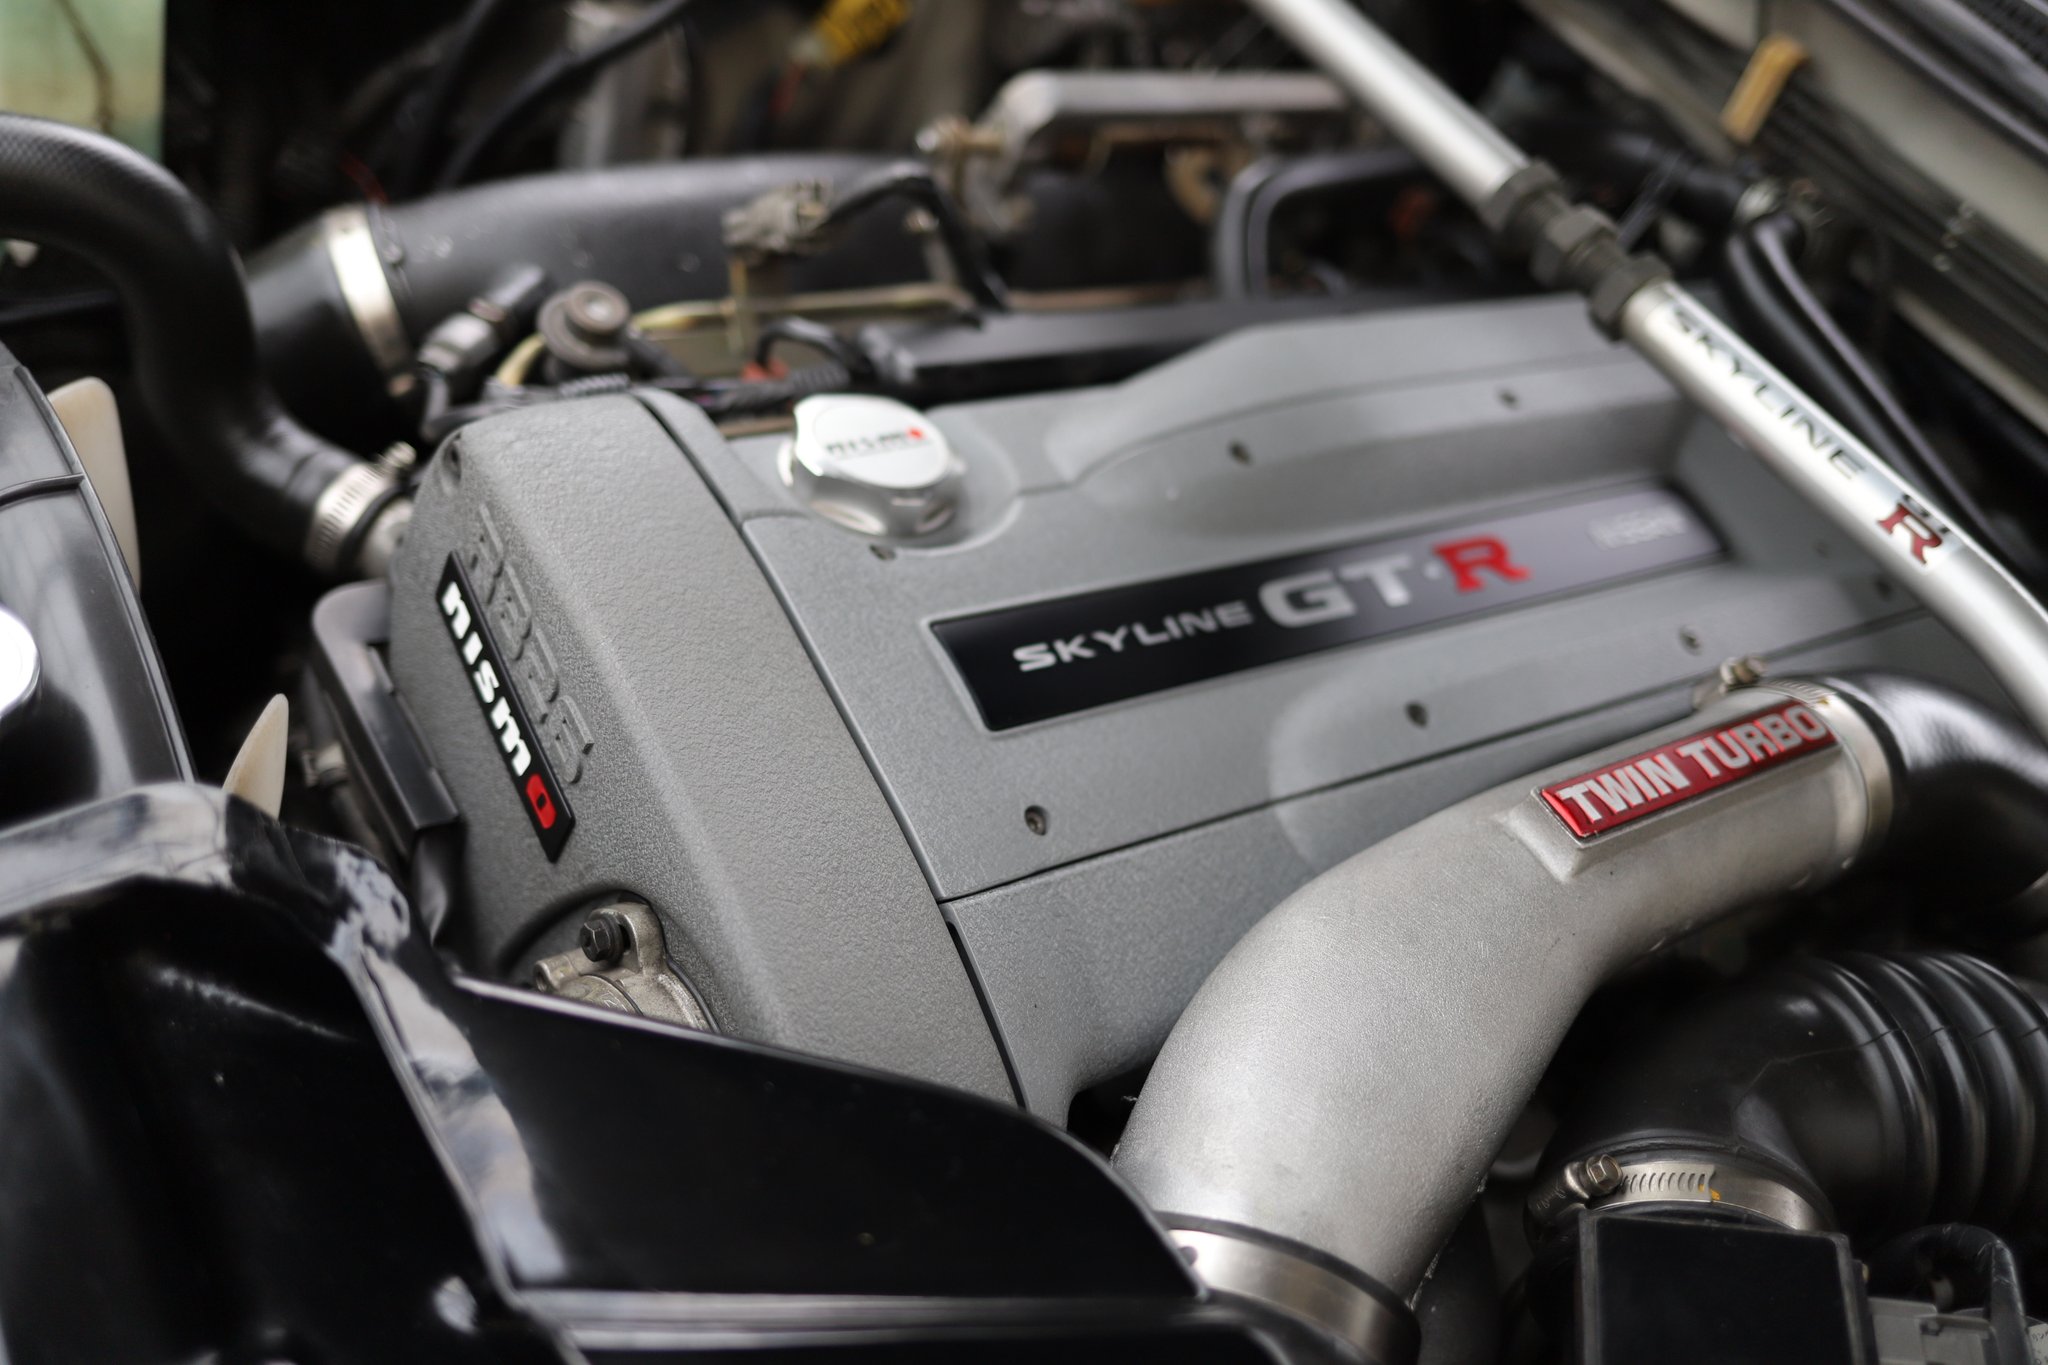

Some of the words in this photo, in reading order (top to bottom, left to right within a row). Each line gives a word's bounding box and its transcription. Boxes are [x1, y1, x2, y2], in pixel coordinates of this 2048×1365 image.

[1673, 308, 1867, 480] SKYLINE
[443, 582, 557, 828] nismo
[1013, 602, 1254, 671] SKYLINE
[1557, 754, 1690, 822] TWIN
[1678, 704, 1826, 778] TURBO
